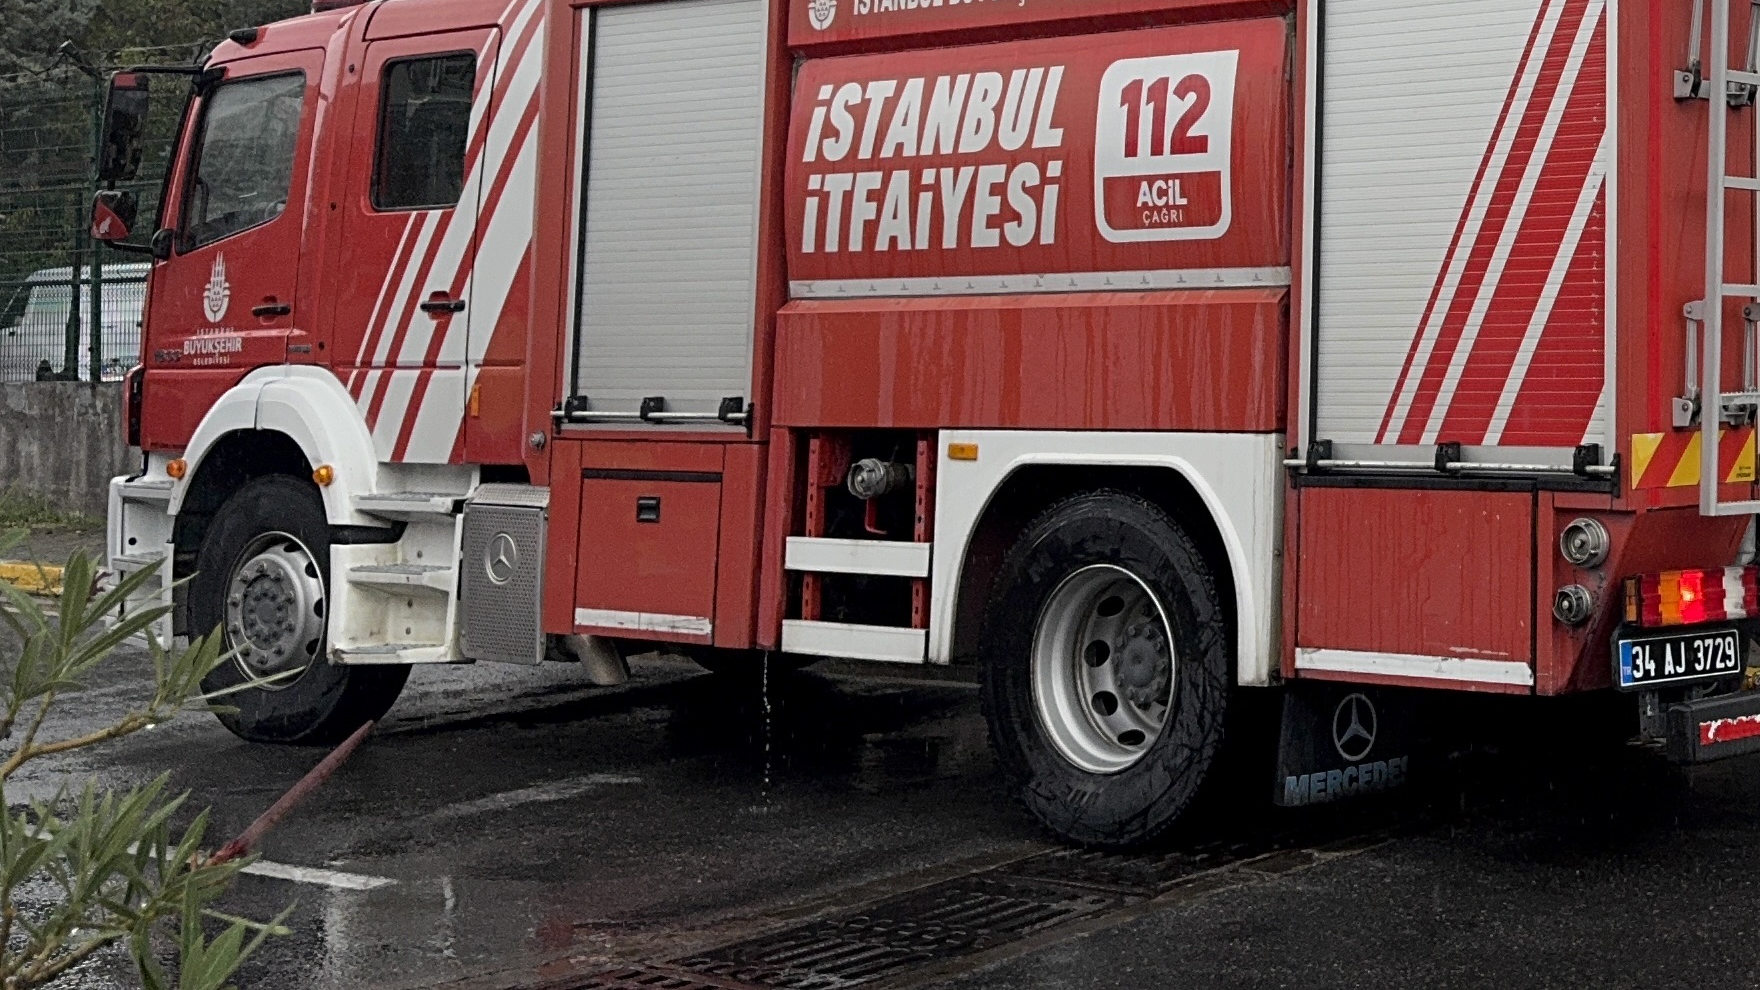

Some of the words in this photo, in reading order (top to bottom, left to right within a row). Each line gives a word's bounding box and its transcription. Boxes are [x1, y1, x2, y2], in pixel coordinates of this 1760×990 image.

[1119, 73, 1211, 159] 112
[1142, 208, 1183, 226] ÇAĞRI
[1632, 646, 1656, 679] 34
[1664, 642, 1686, 676] AJ
[1694, 636, 1736, 671] 3729
